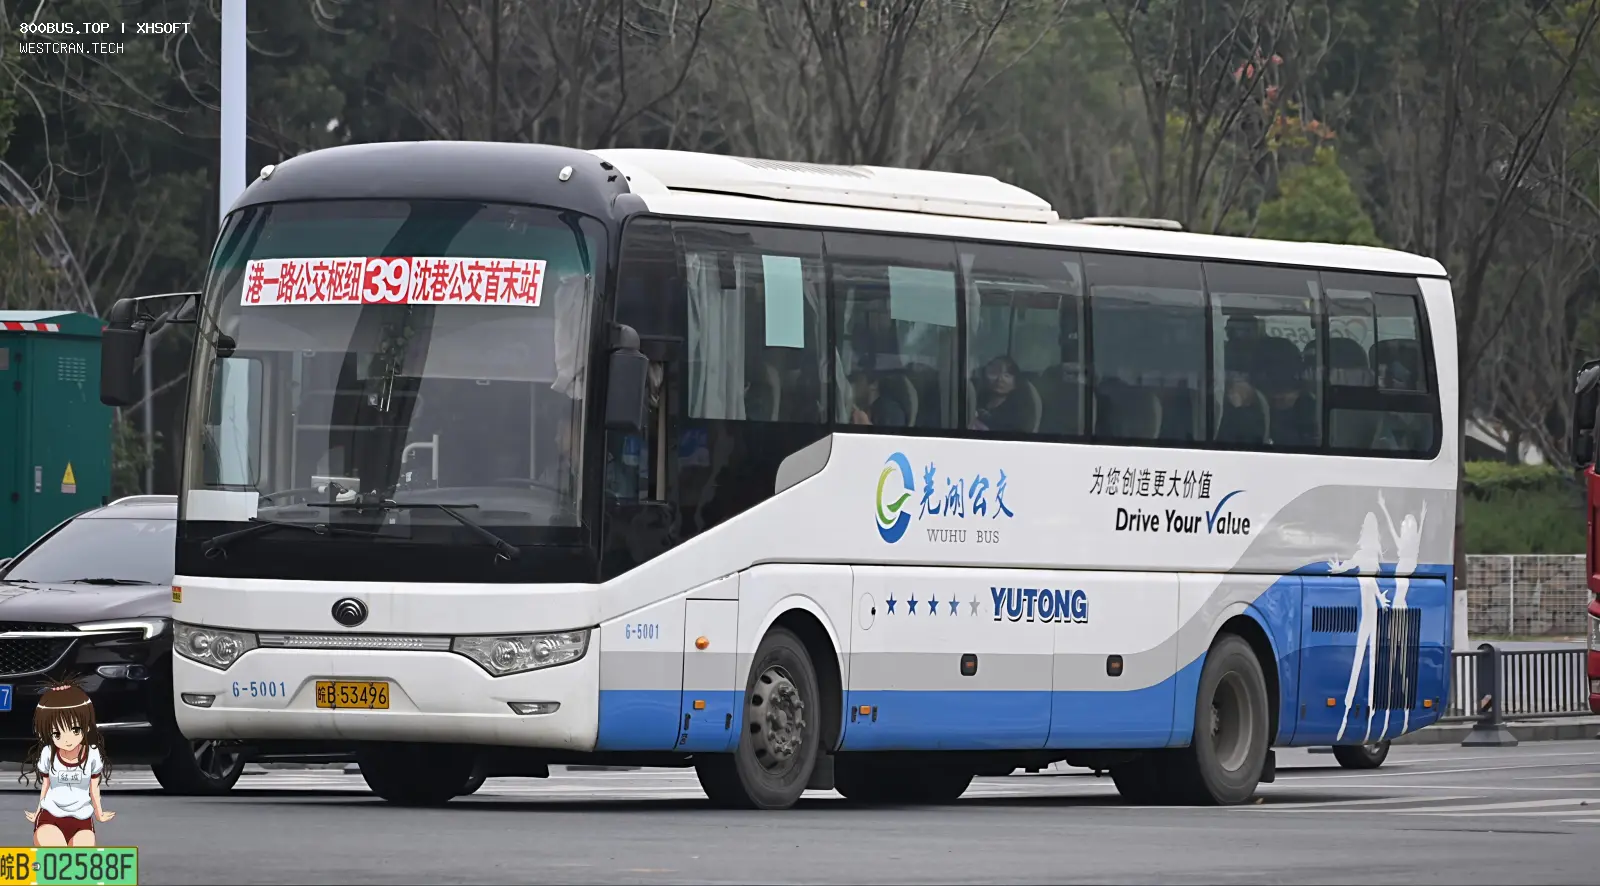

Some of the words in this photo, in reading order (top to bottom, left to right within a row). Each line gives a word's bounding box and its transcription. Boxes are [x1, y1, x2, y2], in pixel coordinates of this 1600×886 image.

[246, 260, 363, 304] 港一路公交枢纽
[363, 258, 411, 302] 39
[411, 259, 541, 304] 沈巷公交首末站
[1089, 466, 1213, 499] 为您创造更大价值
[1115, 507, 1160, 533] Drive
[1165, 509, 1202, 534] Your
[1205, 490, 1250, 535] Value
[927, 528, 967, 543] WUHU
[976, 530, 1000, 544] BUS
[990, 587, 1088, 624] YUTONG
[625, 623, 659, 640] 6-5001
[232, 681, 286, 698] 6-5001
